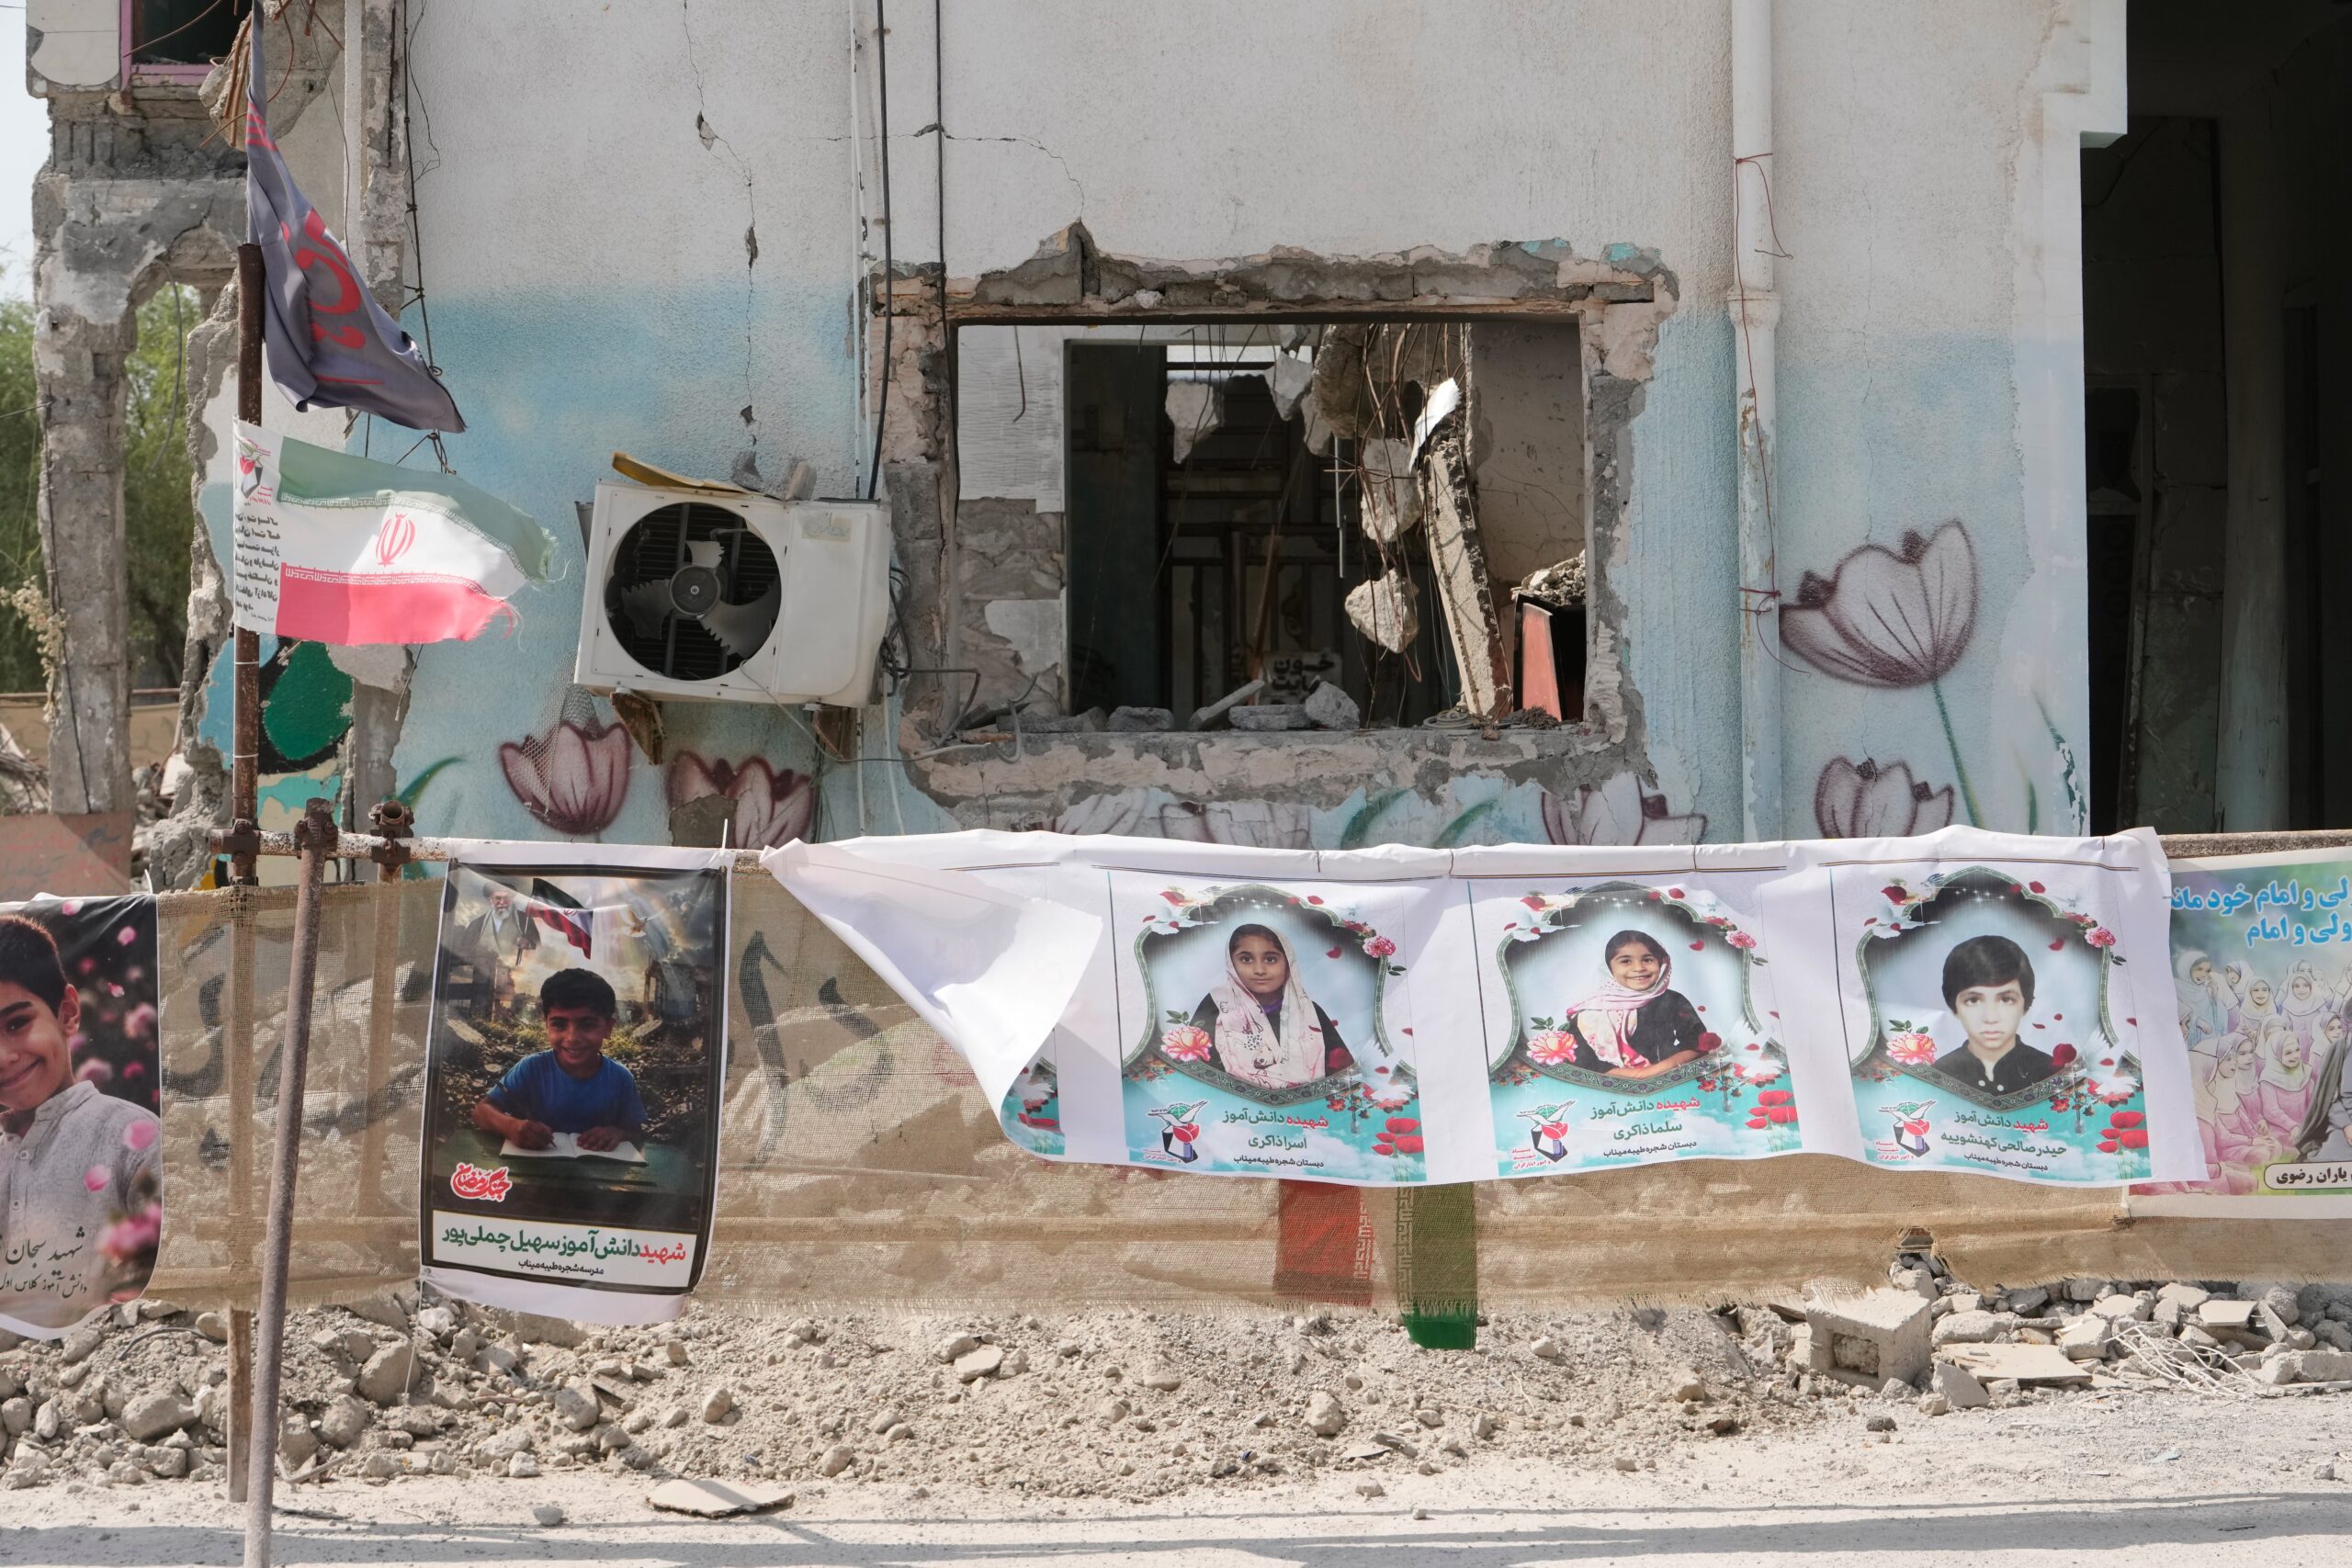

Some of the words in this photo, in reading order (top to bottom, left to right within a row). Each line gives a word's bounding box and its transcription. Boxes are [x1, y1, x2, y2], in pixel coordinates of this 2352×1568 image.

[2170, 886, 2204, 909] مان
[2207, 883, 2254, 917] خود
[2256, 879, 2299, 913] امام
[2301, 888, 2315, 911] و
[2245, 915, 2290, 948] امام
[2292, 924, 2306, 946] و
[1656, 1096, 1702, 1111] شهیده
[1287, 1115, 1329, 1130] شهیده
[1613, 1122, 1650, 1141] ذاکری
[1650, 1121, 1683, 1135] سلما
[2013, 1118, 2049, 1133] شهید
[1248, 1134, 1283, 1149] ذاکری
[1997, 1140, 2037, 1153] صالحی
[2035, 1145, 2067, 1157] حیدر
[2276, 1168, 2314, 1184] رضوی
[2316, 1167, 2347, 1184] یاران
[47, 1225, 85, 1276] شهید
[510, 1229, 560, 1254] سهیل
[639, 1242, 687, 1265] شهید
[518, 1259, 542, 1270] میناب
[580, 1265, 605, 1276] مدرسه
[15, 1272, 43, 1292] کلاس
